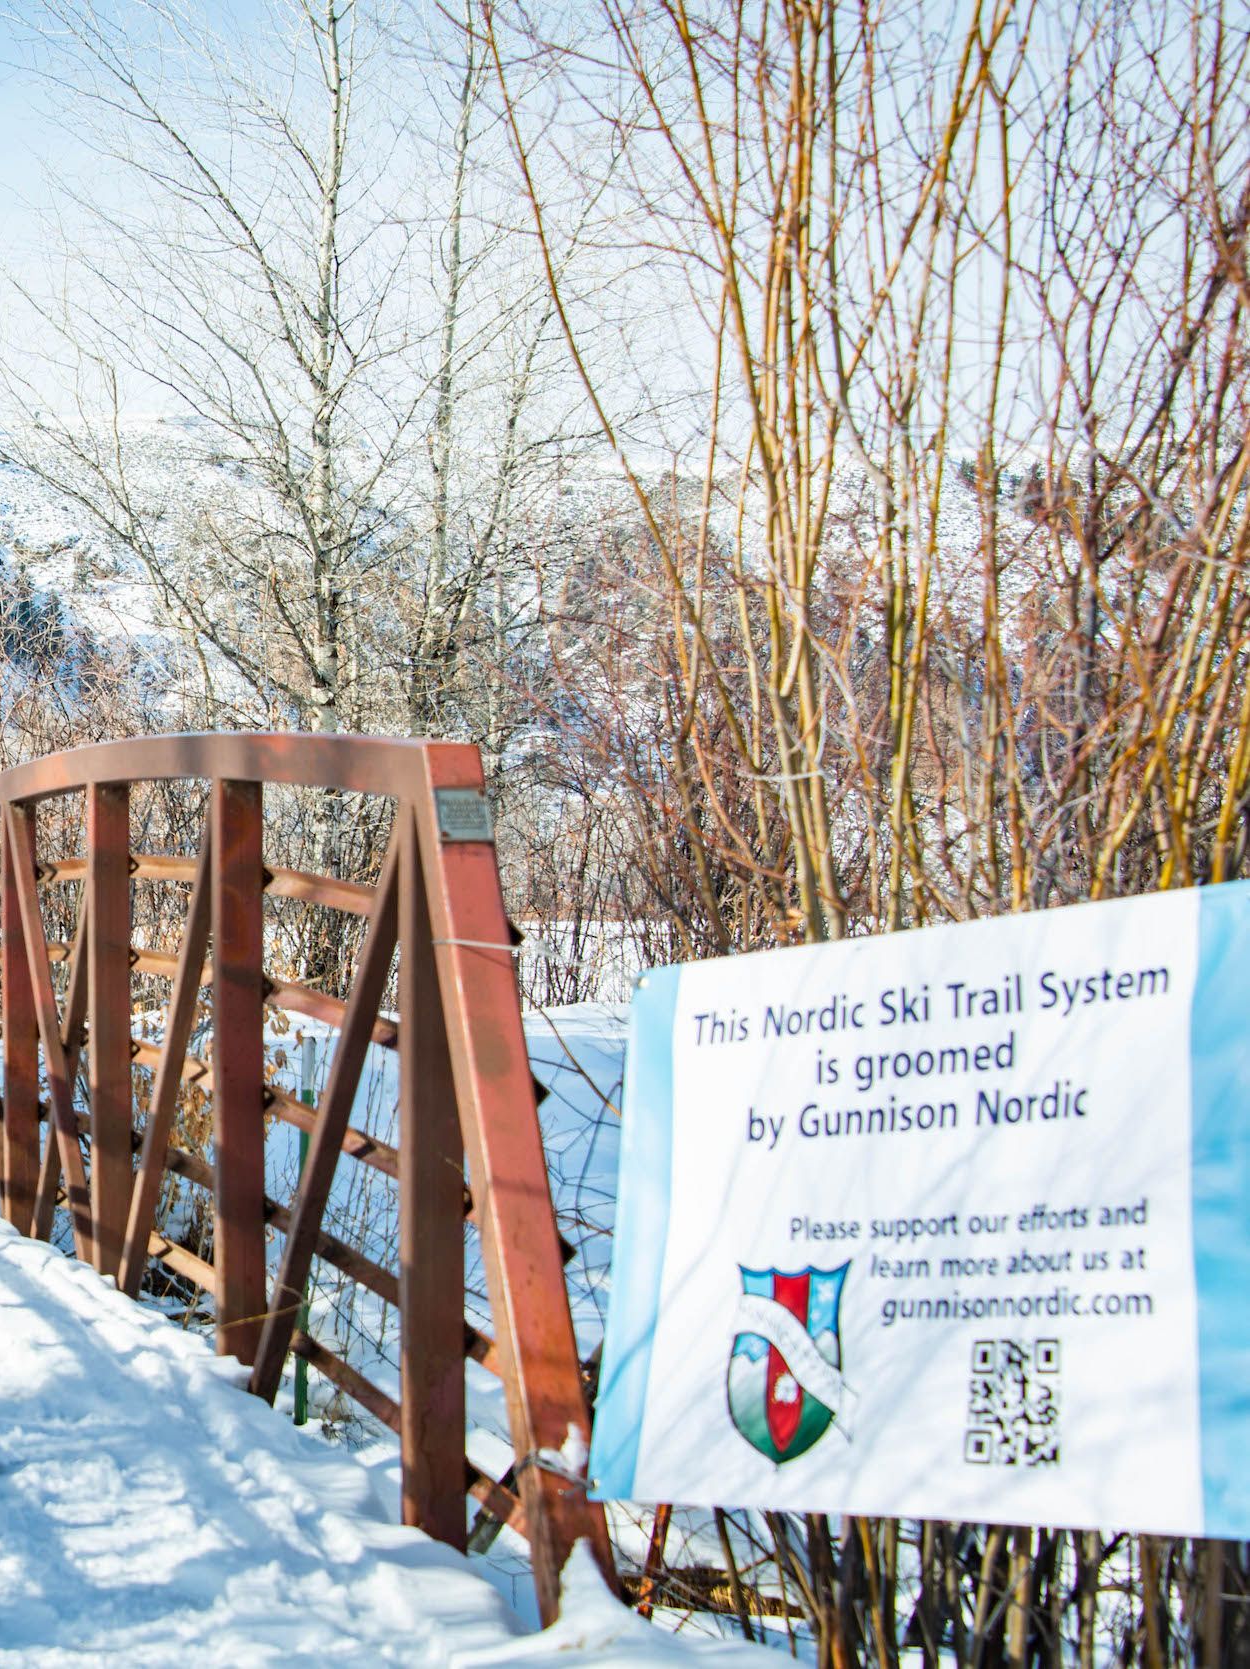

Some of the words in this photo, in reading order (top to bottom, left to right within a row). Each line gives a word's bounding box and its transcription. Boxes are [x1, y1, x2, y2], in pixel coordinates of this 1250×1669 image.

[693, 1011, 750, 1046] This
[763, 994, 865, 1038] Nordic
[880, 984, 930, 1026] Ski
[946, 973, 1023, 1019] Trail
[1040, 964, 1171, 1016] System
[817, 1049, 839, 1085] is
[855, 1031, 1016, 1092] groomed
[747, 1107, 785, 1150] by
[798, 1095, 958, 1138] Gunnison
[975, 1081, 1088, 1126] Nordic
[790, 1215, 862, 1242] Please
[869, 1212, 959, 1244] support
[968, 1215, 1009, 1235] our
[1018, 1204, 1089, 1232] efforts
[1099, 1198, 1148, 1227] and
[871, 1255, 930, 1278] learn
[941, 1258, 999, 1277] more
[1007, 1249, 1072, 1275] about
[1083, 1251, 1109, 1271] us
[1121, 1248, 1145, 1270] at
[881, 1289, 1153, 1327] gunnisonnordic.com
